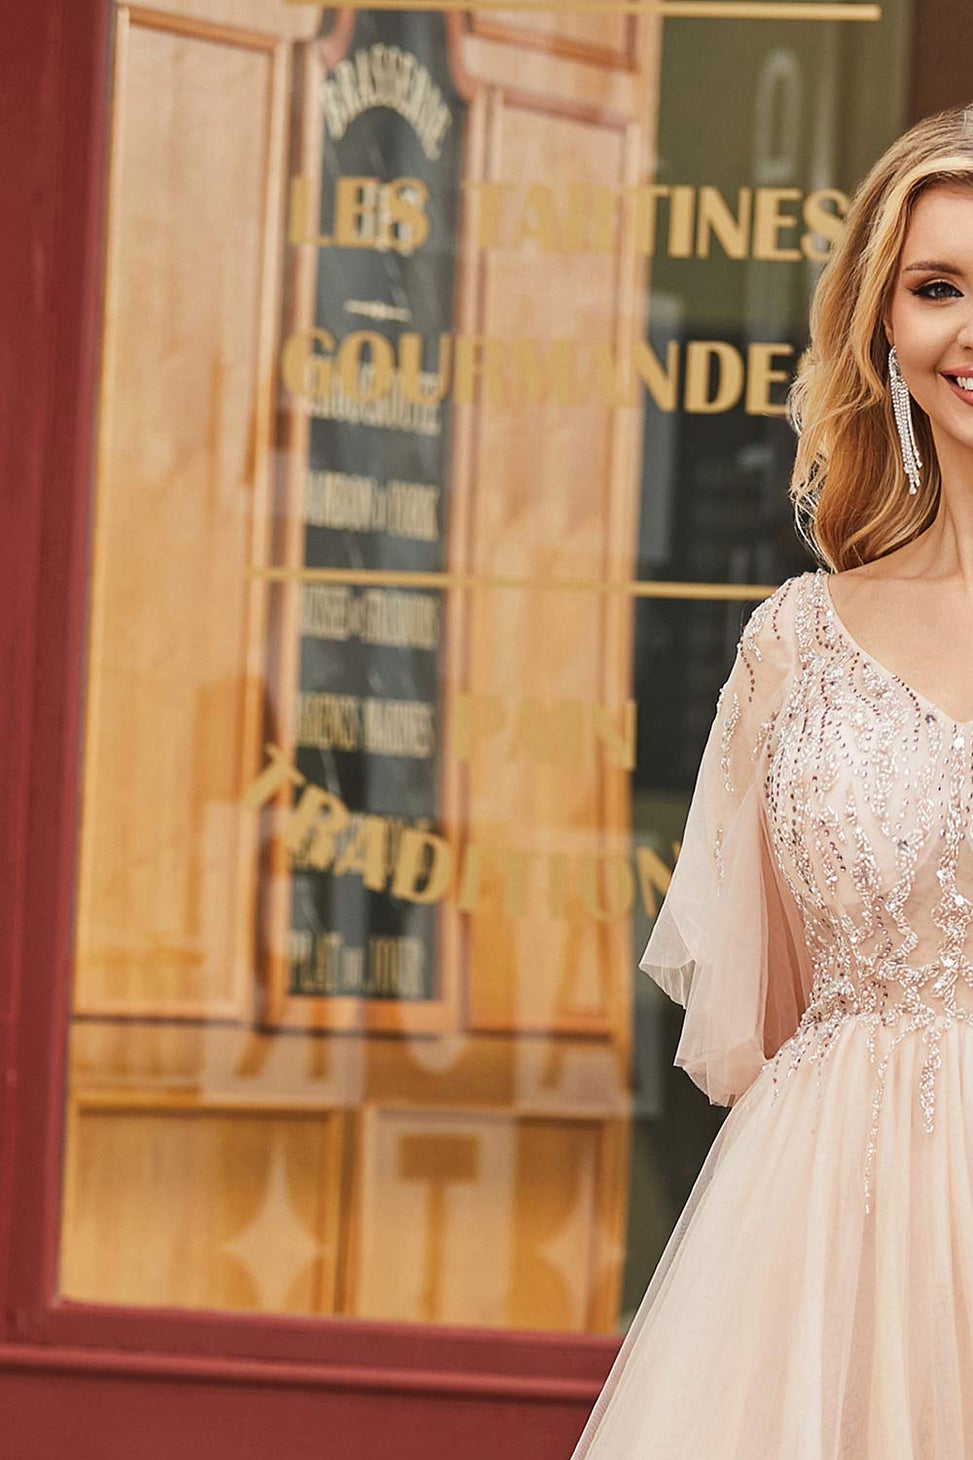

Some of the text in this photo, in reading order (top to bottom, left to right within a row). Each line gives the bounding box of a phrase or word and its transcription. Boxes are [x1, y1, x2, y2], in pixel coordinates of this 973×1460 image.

[289, 175, 430, 250] LES
[461, 183, 852, 263] TARTINES
[453, 694, 637, 771] PAIN
